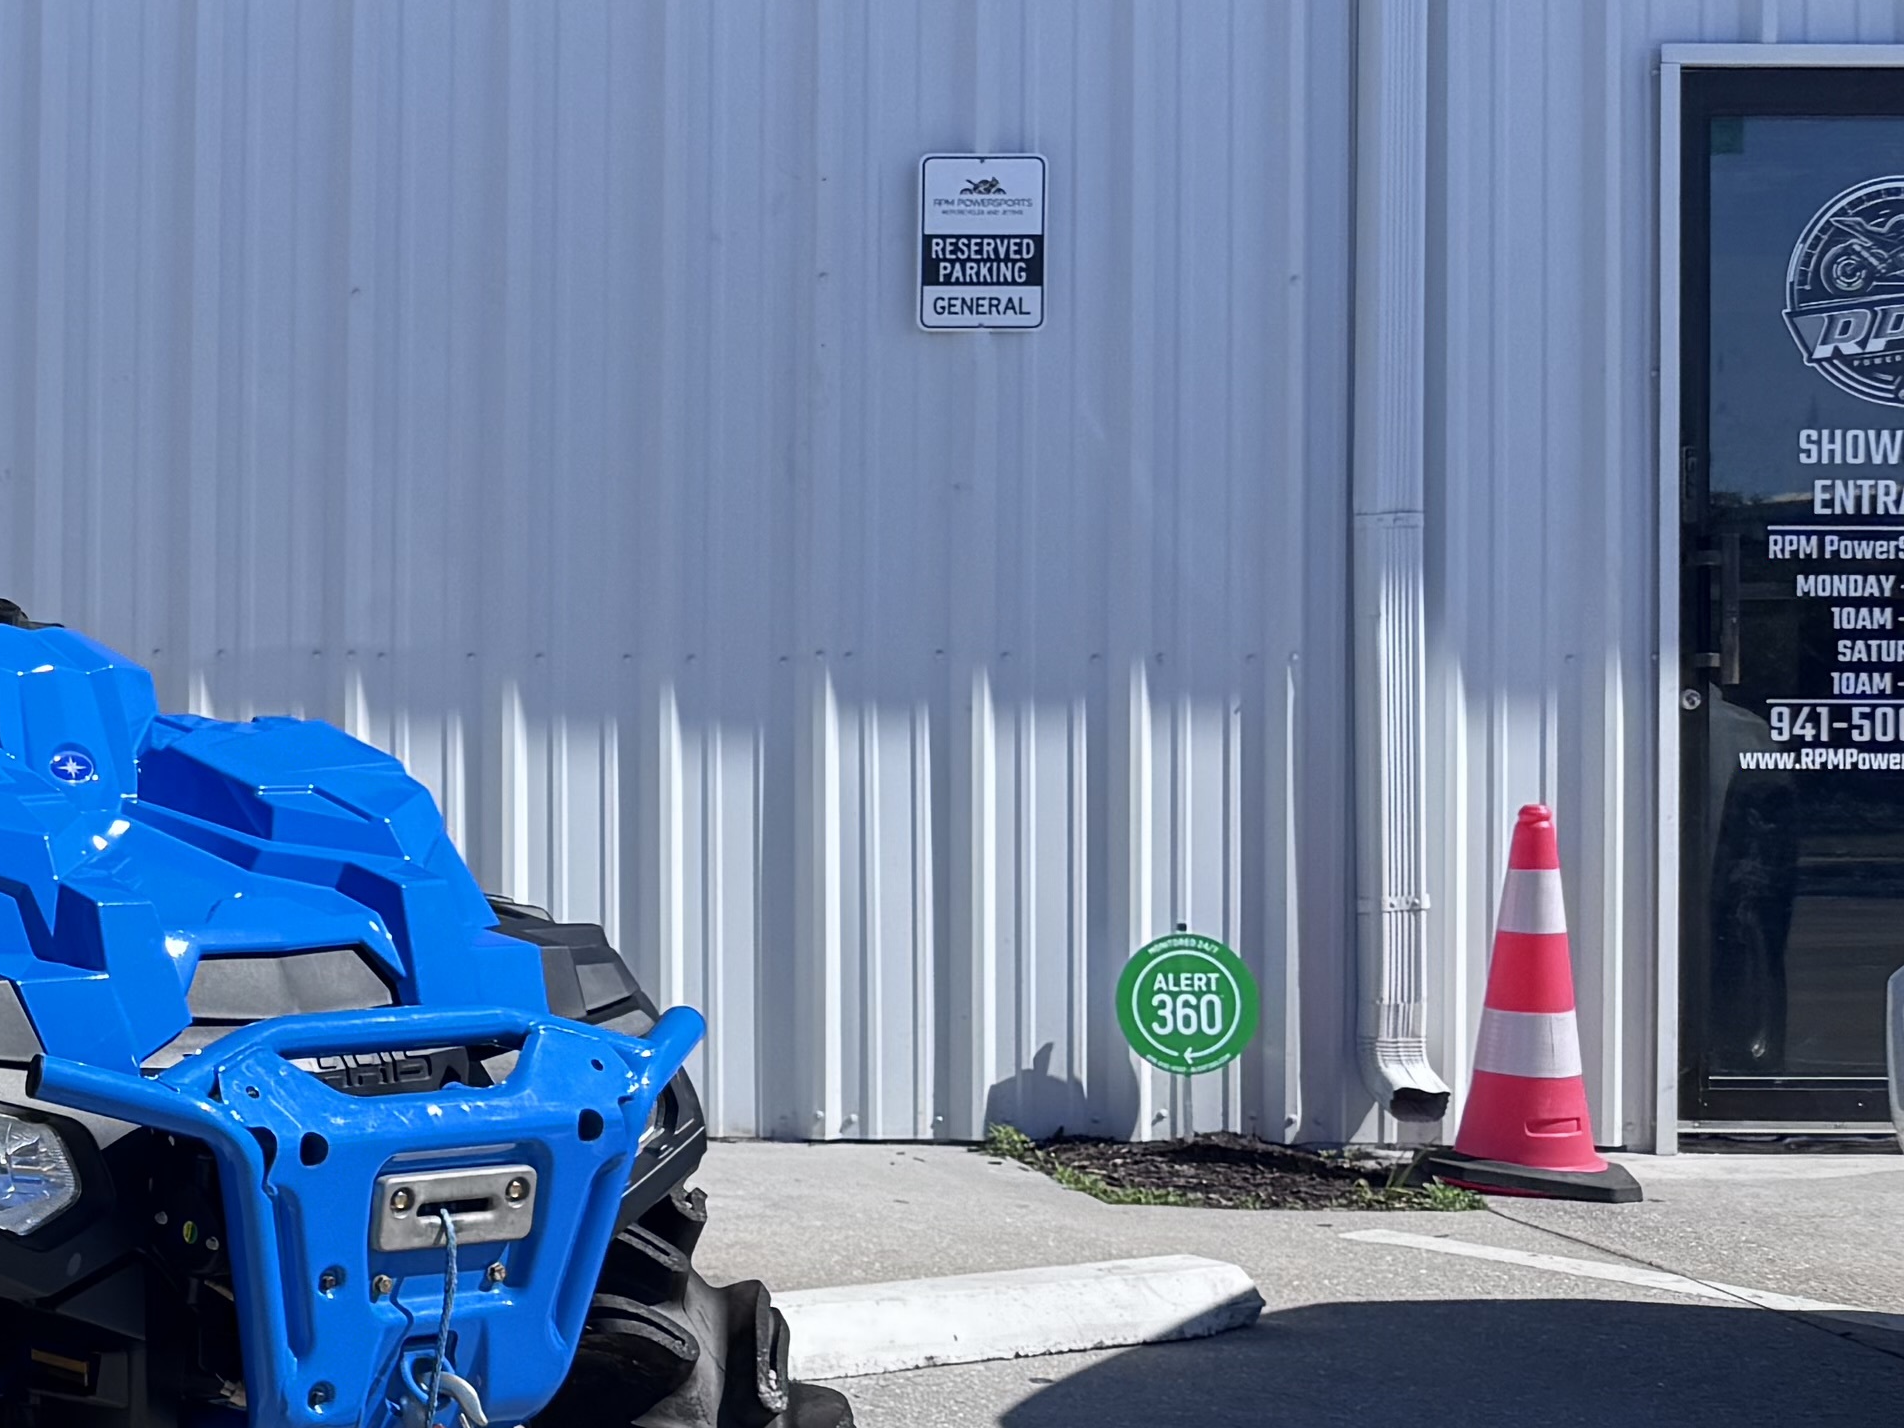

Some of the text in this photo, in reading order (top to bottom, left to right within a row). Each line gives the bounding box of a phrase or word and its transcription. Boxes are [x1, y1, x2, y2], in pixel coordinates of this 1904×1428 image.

[931, 237, 1035, 260] RESERVED
[939, 261, 1027, 283] PARKING
[933, 296, 1031, 316] GENERAL
[1799, 429, 1904, 465] SHOW
[1768, 535, 1818, 559] RPM
[1796, 574, 1896, 597] MONDAY
[1830, 607, 1893, 630] 10AM
[1830, 672, 1892, 695] 10AM
[1153, 972, 1220, 992] ALERT
[1151, 993, 1223, 1036] 360
